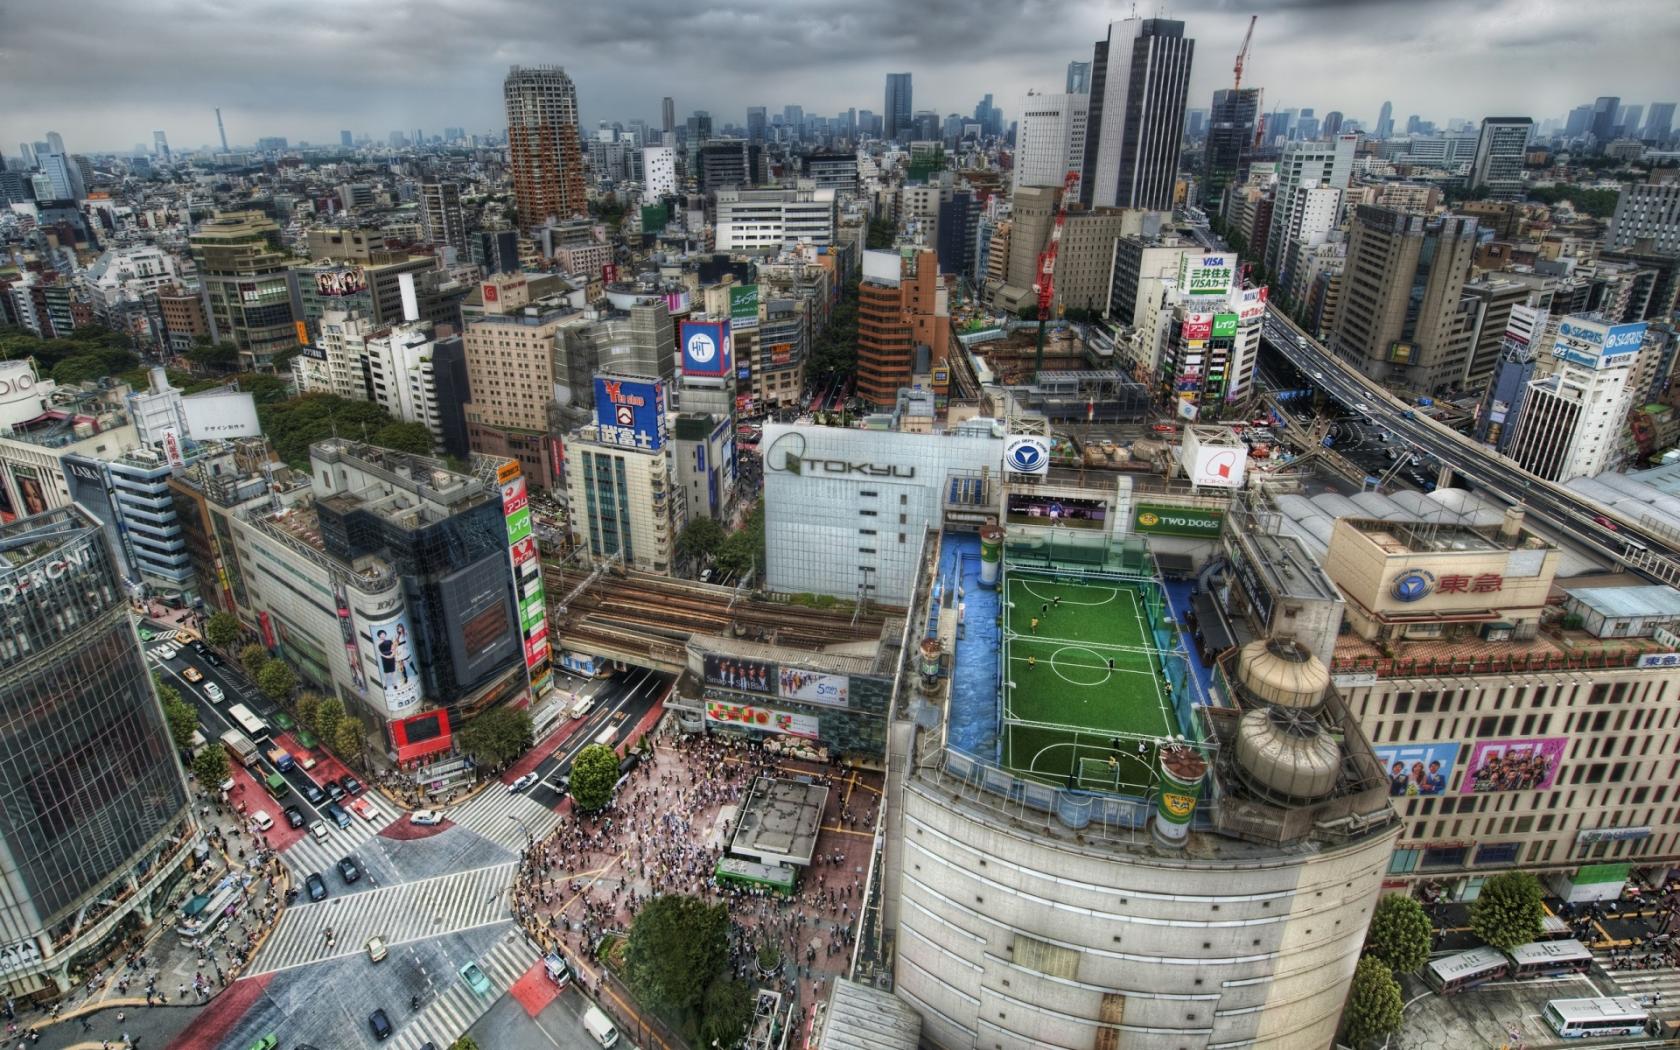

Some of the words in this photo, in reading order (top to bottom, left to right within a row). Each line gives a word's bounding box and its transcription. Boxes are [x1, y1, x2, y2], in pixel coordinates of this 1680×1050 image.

[1203, 257, 1224, 266] VISA
[1192, 268, 1231, 278] 三井住友
[1190, 279, 1230, 288] VISAカード
[1215, 321, 1235, 329] レイク
[601, 424, 652, 449] 武富士
[70, 463, 100, 481] ZARA
[800, 458, 916, 479] TOKYU
[507, 498, 527, 513] アコム
[509, 517, 529, 535] レイク
[1160, 516, 1185, 526] TWO
[1187, 518, 1219, 528] DOGS
[1435, 573, 1503, 594] 東急
[377, 599, 395, 610] 109
[1643, 655, 1680, 666] 東急
